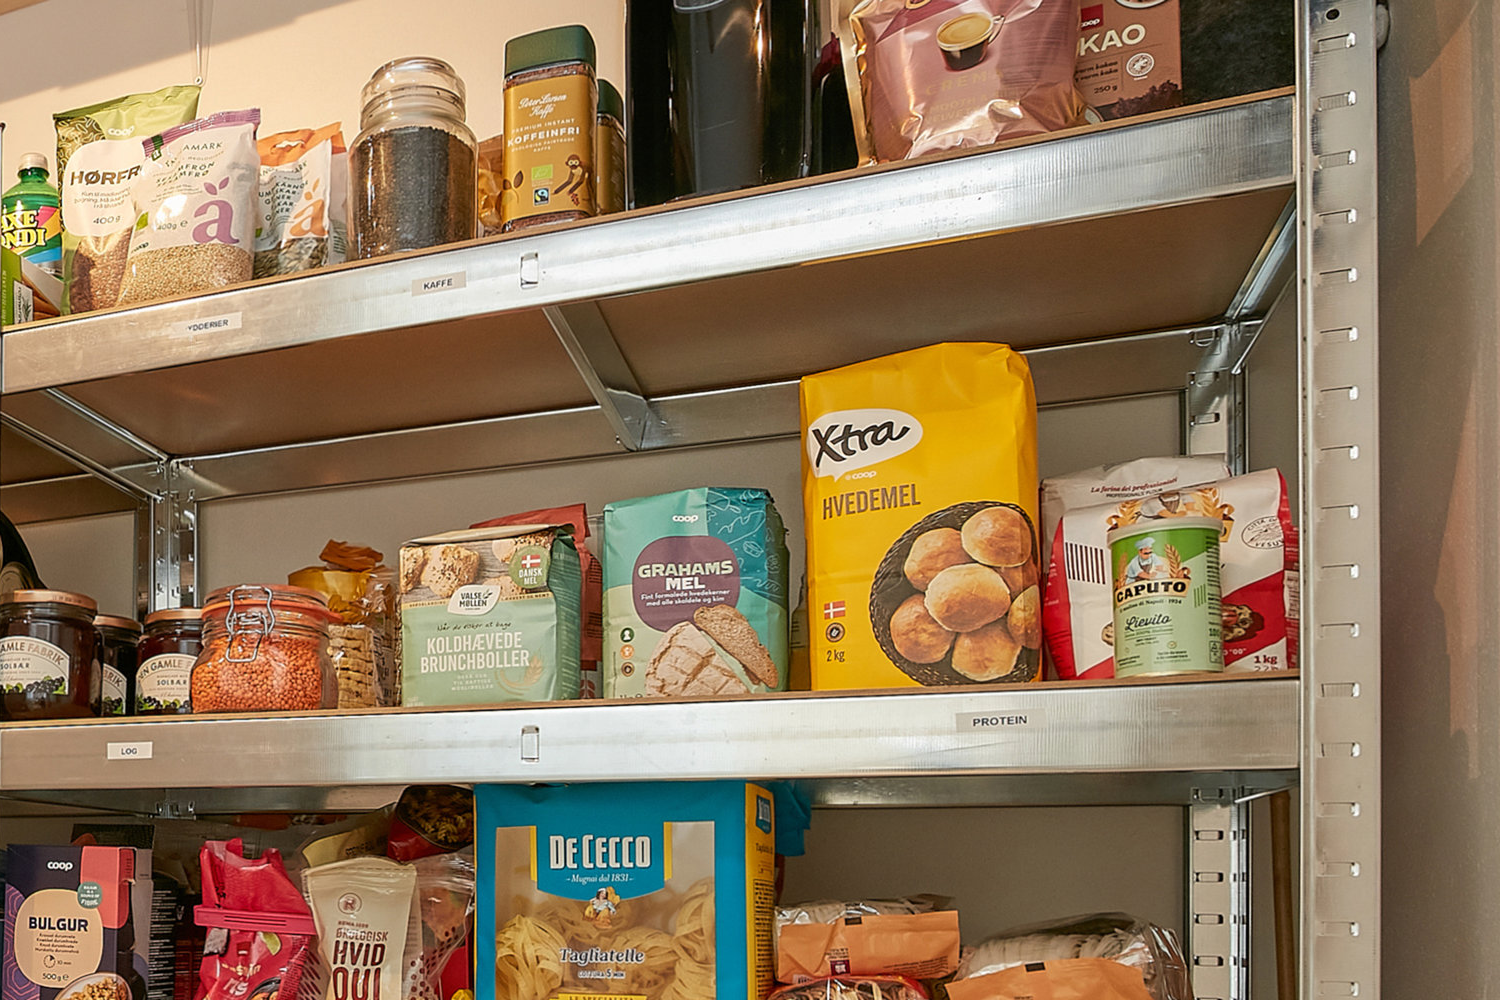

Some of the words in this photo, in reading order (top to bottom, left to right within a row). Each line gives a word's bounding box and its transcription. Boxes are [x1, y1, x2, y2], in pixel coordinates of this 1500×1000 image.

[1079, 24, 1146, 56] KAO
[108, 126, 134, 136] coop
[511, 123, 542, 134] PREMIUM
[545, 118, 575, 127] INSTANT
[507, 127, 580, 147] KOFFEINFRI
[70, 165, 142, 186] HØRFR
[1, 228, 47, 249] NDI
[423, 278, 453, 290] KAFFE
[811, 421, 910, 468] Xtra
[823, 484, 921, 519] HVEDEMEL
[672, 515, 699, 523] coop
[519, 567, 543, 578] DANSK
[638, 560, 734, 578] GRAHAMS
[523, 576, 538, 585] MEL
[665, 577, 706, 591] MEL
[461, 592, 482, 600] VALSE
[1117, 581, 1186, 603] CAPUTO
[459, 599, 487, 608] MØLLEN
[1125, 614, 1172, 632] Lievito
[427, 632, 522, 654] KOLDHÆVEDE
[27, 643, 65, 665] FABRIK
[826, 649, 833, 662] 2
[835, 649, 845, 662] kg
[1263, 655, 1278, 665] kg
[150, 660, 182, 671] GAMLE
[420, 650, 530, 673] BRUNCHBOLLER
[973, 715, 1027, 727] PROTEIN
[121, 747, 138, 756] LOG
[582, 834, 651, 869] CECCO
[47, 861, 73, 871] coop
[594, 873, 610, 882] dal
[610, 873, 629, 882] 1831
[29, 917, 88, 932] BULGUR
[333, 940, 385, 966] HVID
[560, 948, 645, 966] Tagliatelle
[42, 972, 57, 980] 500
[606, 969, 612, 978] 5
